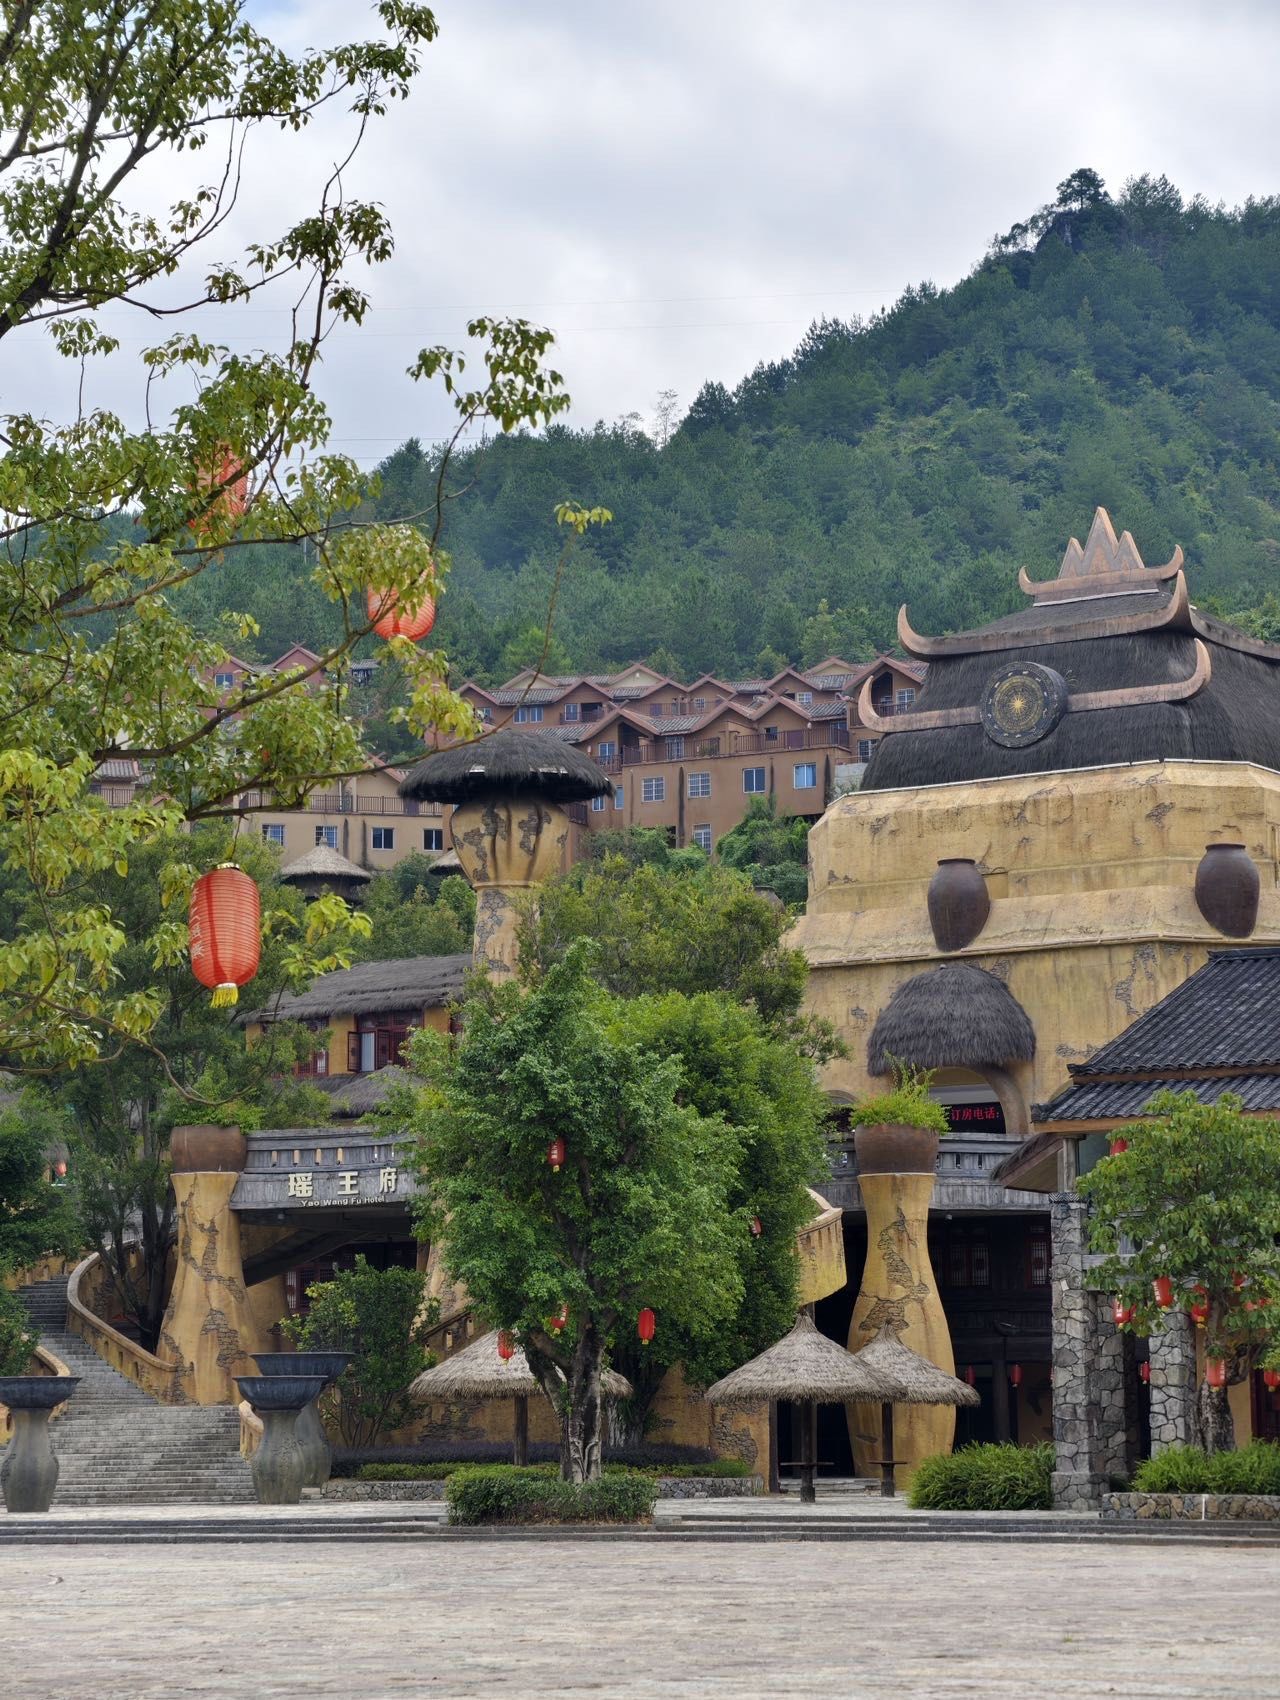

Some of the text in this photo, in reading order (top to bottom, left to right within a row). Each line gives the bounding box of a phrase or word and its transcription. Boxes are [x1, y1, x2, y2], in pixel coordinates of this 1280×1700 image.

[288, 1167, 397, 1198] 瑶王府
[323, 1198, 348, 1206] Wang
[364, 1195, 384, 1203] Hotel
